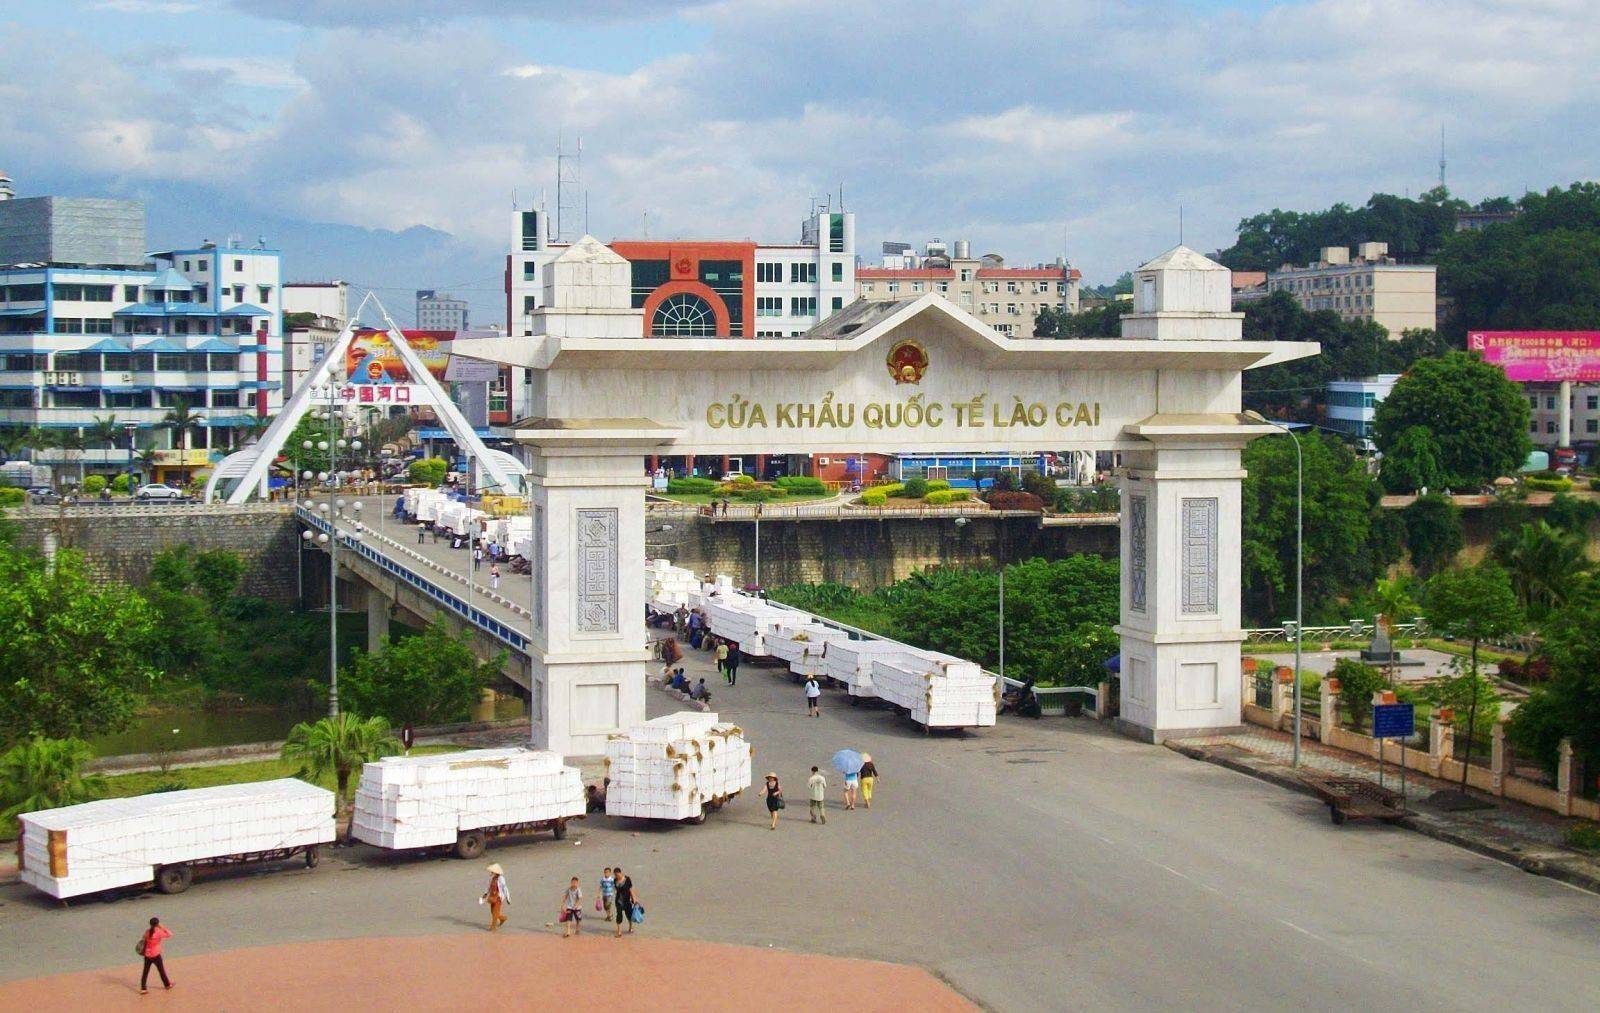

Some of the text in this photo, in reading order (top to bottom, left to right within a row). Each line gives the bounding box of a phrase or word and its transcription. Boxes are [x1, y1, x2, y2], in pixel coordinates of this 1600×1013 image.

[341, 386, 410, 403] 中国河口
[706, 390, 1100, 429] CỬA KHẨU QUỐC TẾ LÀO CAI
